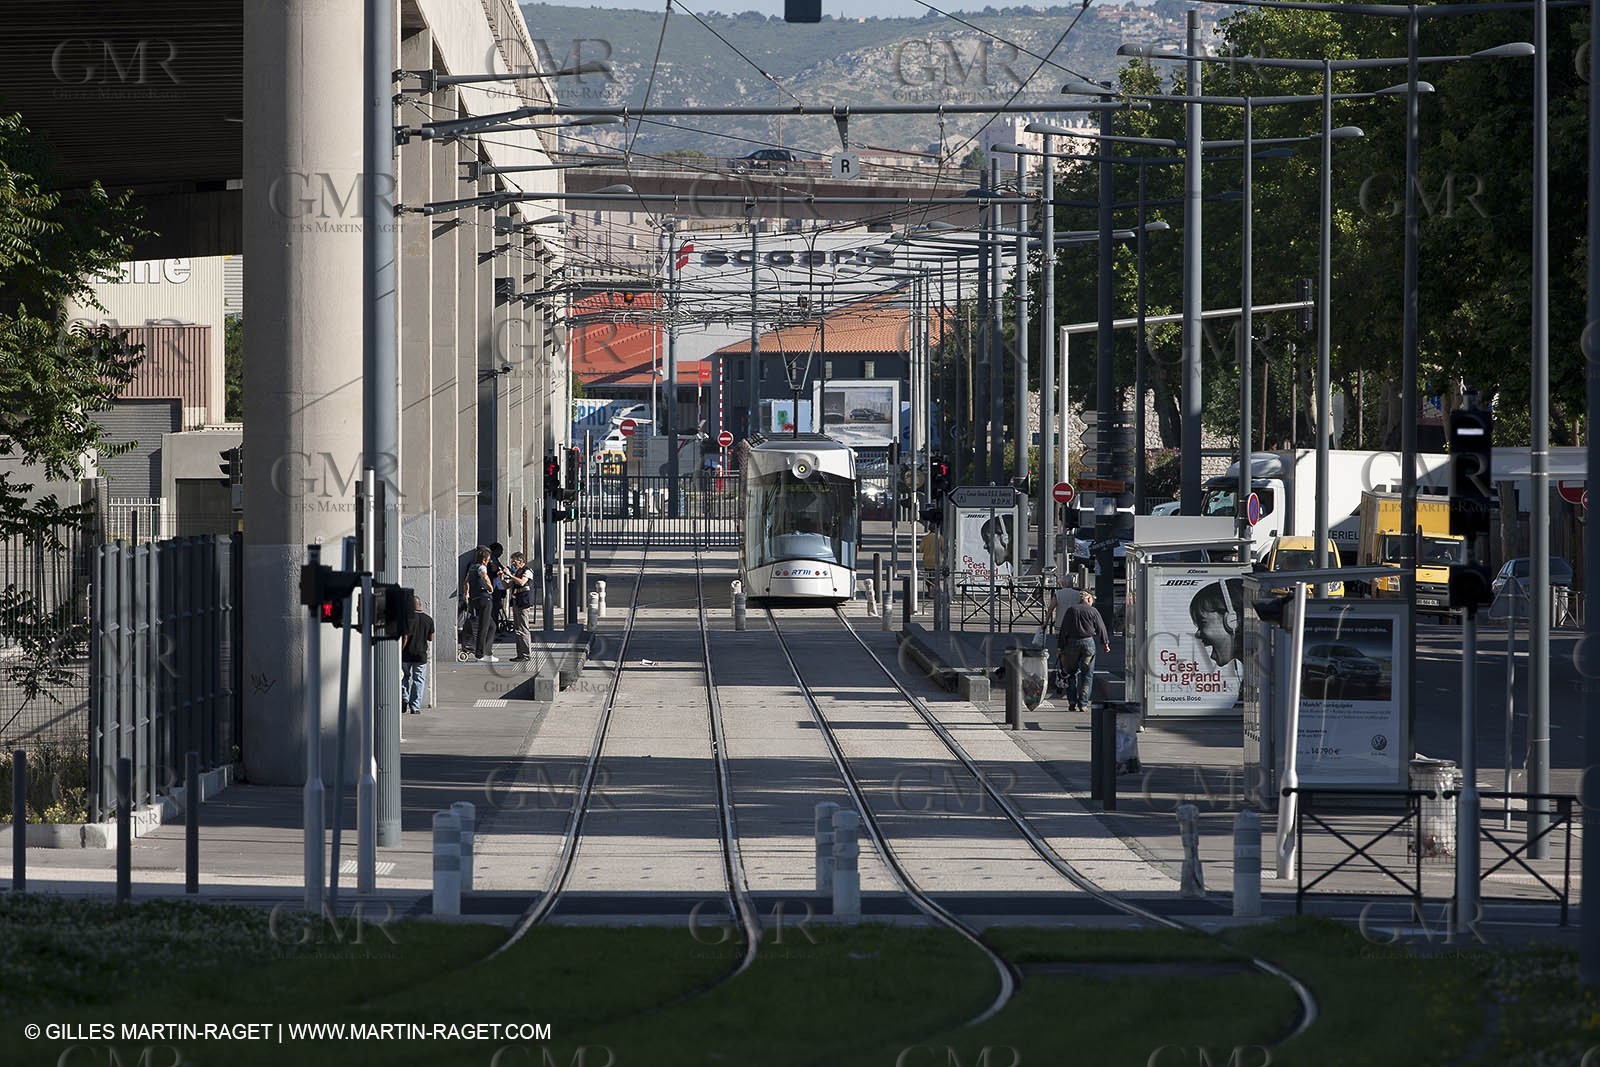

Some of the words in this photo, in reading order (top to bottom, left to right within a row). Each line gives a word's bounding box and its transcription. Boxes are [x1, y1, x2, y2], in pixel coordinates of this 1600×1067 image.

[840, 158, 850, 173] R
[1163, 579, 1202, 587] BOSE
[1169, 660, 1199, 672] c'est
[1160, 672, 1178, 682] un
[1182, 670, 1221, 685] grand
